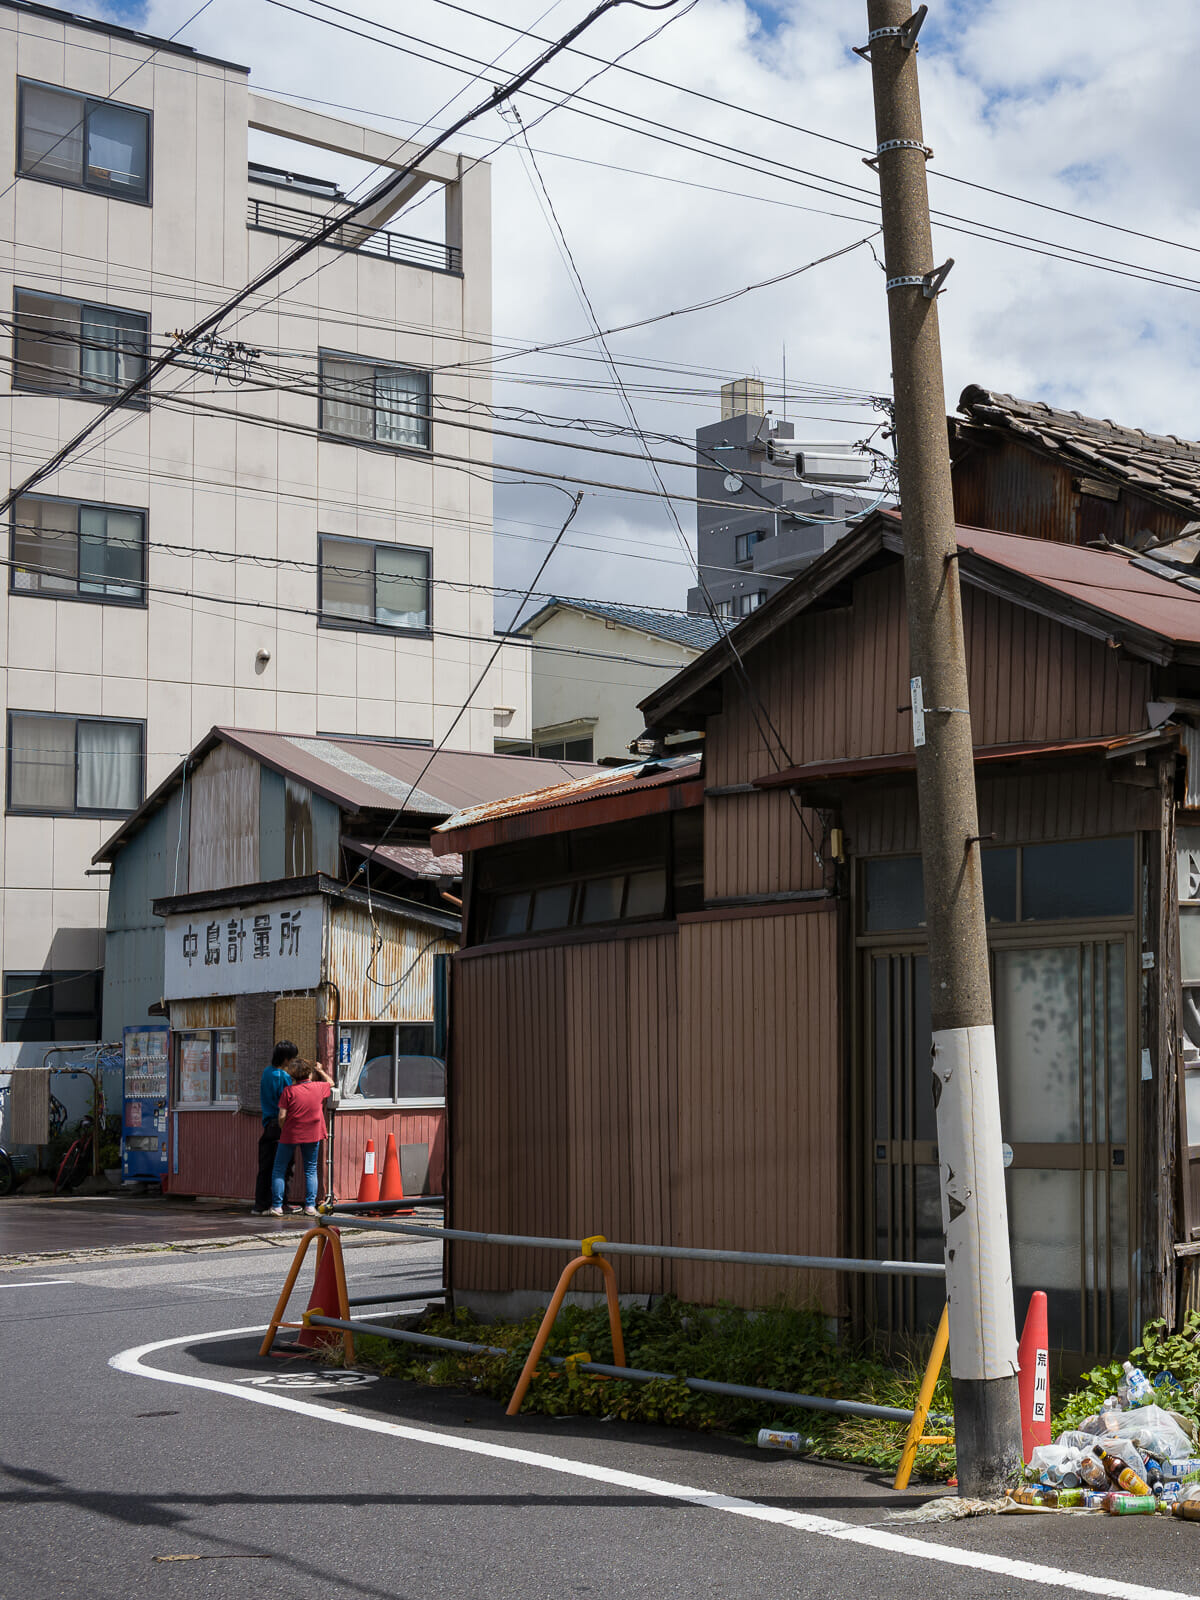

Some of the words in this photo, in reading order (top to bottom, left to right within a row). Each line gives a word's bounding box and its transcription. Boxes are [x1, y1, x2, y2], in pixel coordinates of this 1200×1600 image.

[183, 911, 301, 967] 中島計量所
[1036, 1353, 1047, 1416] 荒川区
